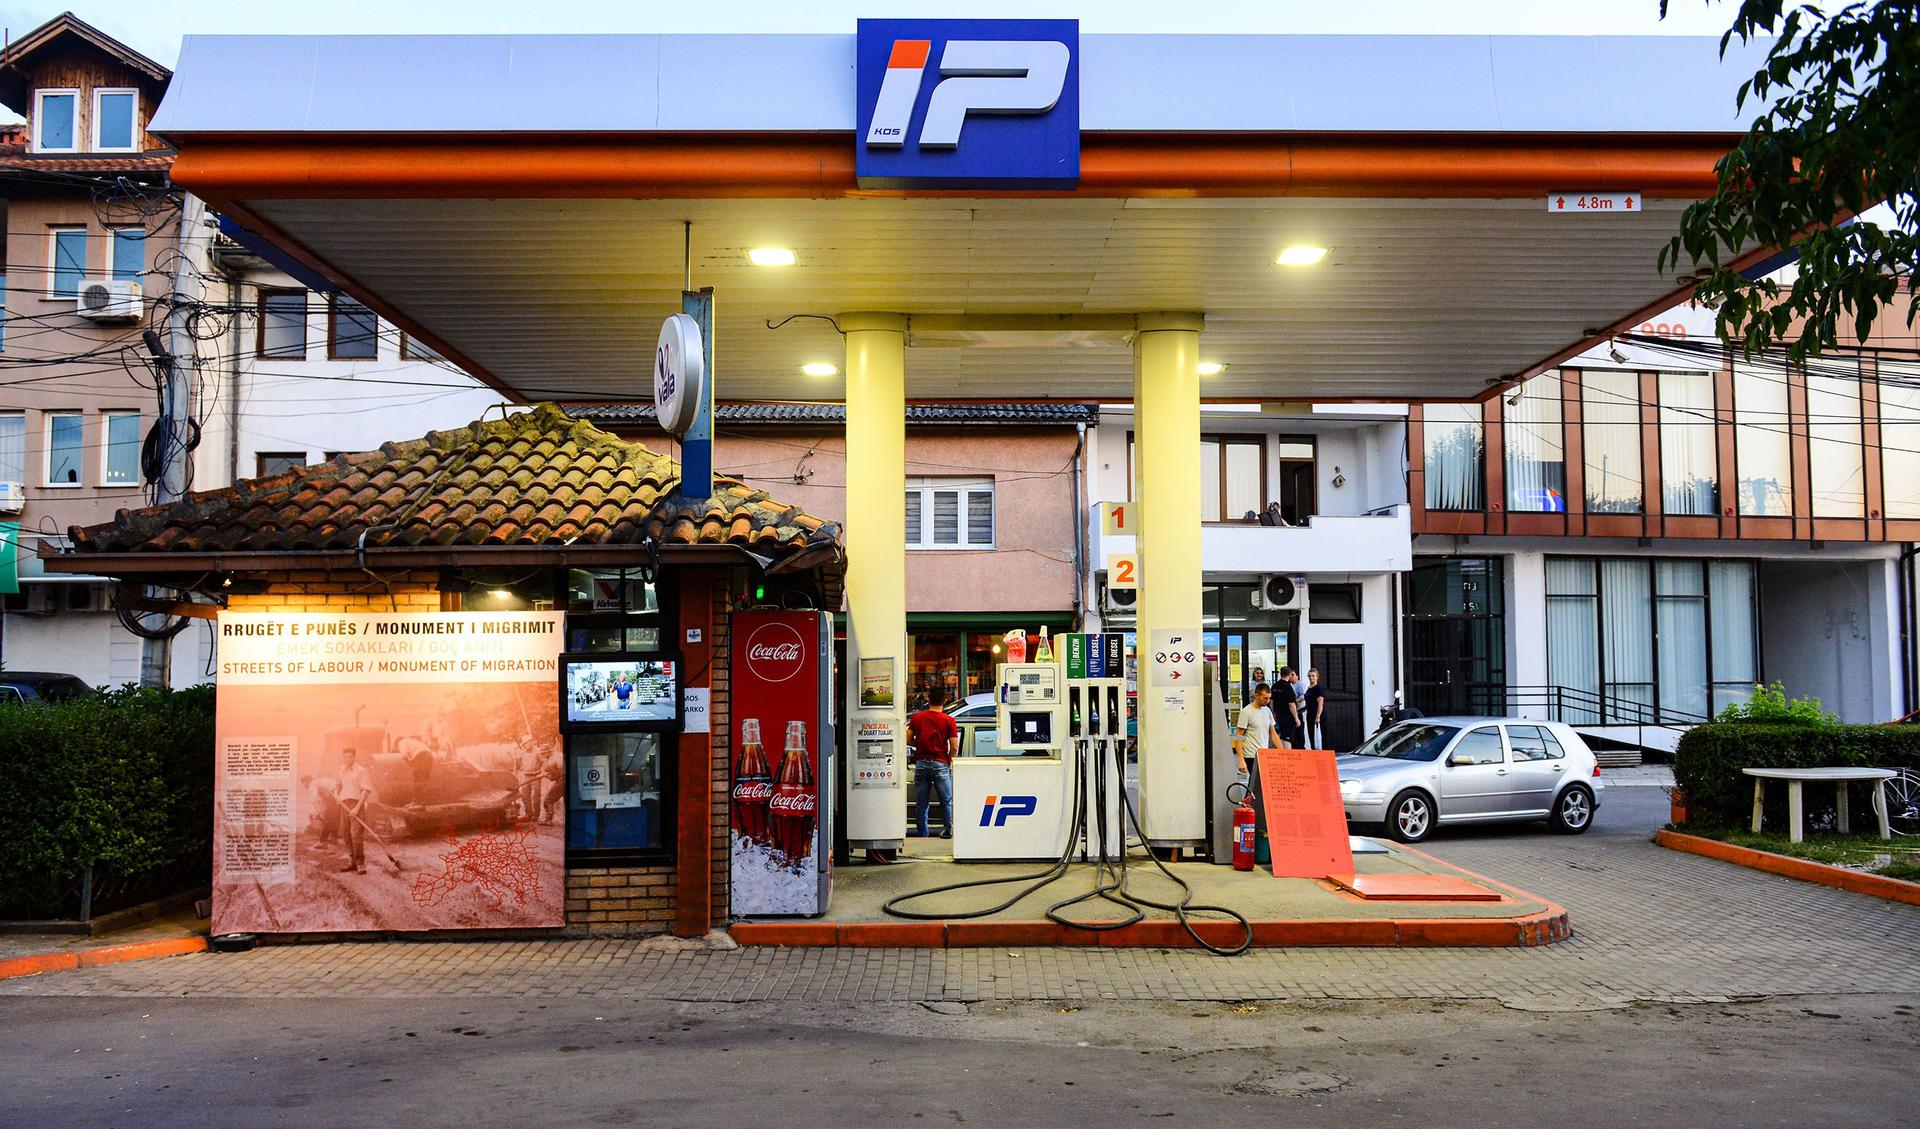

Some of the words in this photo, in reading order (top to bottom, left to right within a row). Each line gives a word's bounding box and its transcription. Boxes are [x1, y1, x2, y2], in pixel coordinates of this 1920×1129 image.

[873, 128, 901, 136] KOS
[1577, 196, 1613, 209] 4.8m
[659, 368, 675, 405] vala
[1111, 506, 1124, 529] 1
[1115, 560, 1135, 583] 2
[223, 619, 284, 637] RRUGËT
[291, 623, 300, 636] E
[306, 620, 357, 636] PUNËS
[376, 622, 464, 635] MONUMENT
[471, 622, 475, 634] I
[482, 621, 556, 634] MIGRIMIT
[277, 642, 319, 655] EMEK
[324, 641, 413, 655] SOKAKLARI
[749, 643, 801, 660] Coca-Cola
[1071, 638, 1080, 659] BENZIN
[1091, 639, 1100, 658] DIESEL
[1110, 638, 1119, 658] DIESEL
[223, 661, 283, 674] STREETS
[287, 661, 305, 673] OF
[309, 660, 364, 673] LABOUR
[378, 660, 456, 672] MONUMENT
[460, 660, 478, 672] OF
[482, 659, 556, 671] MIGRATION
[733, 782, 773, 799] Coca-Cola
[769, 792, 816, 811] Coca-Cola
